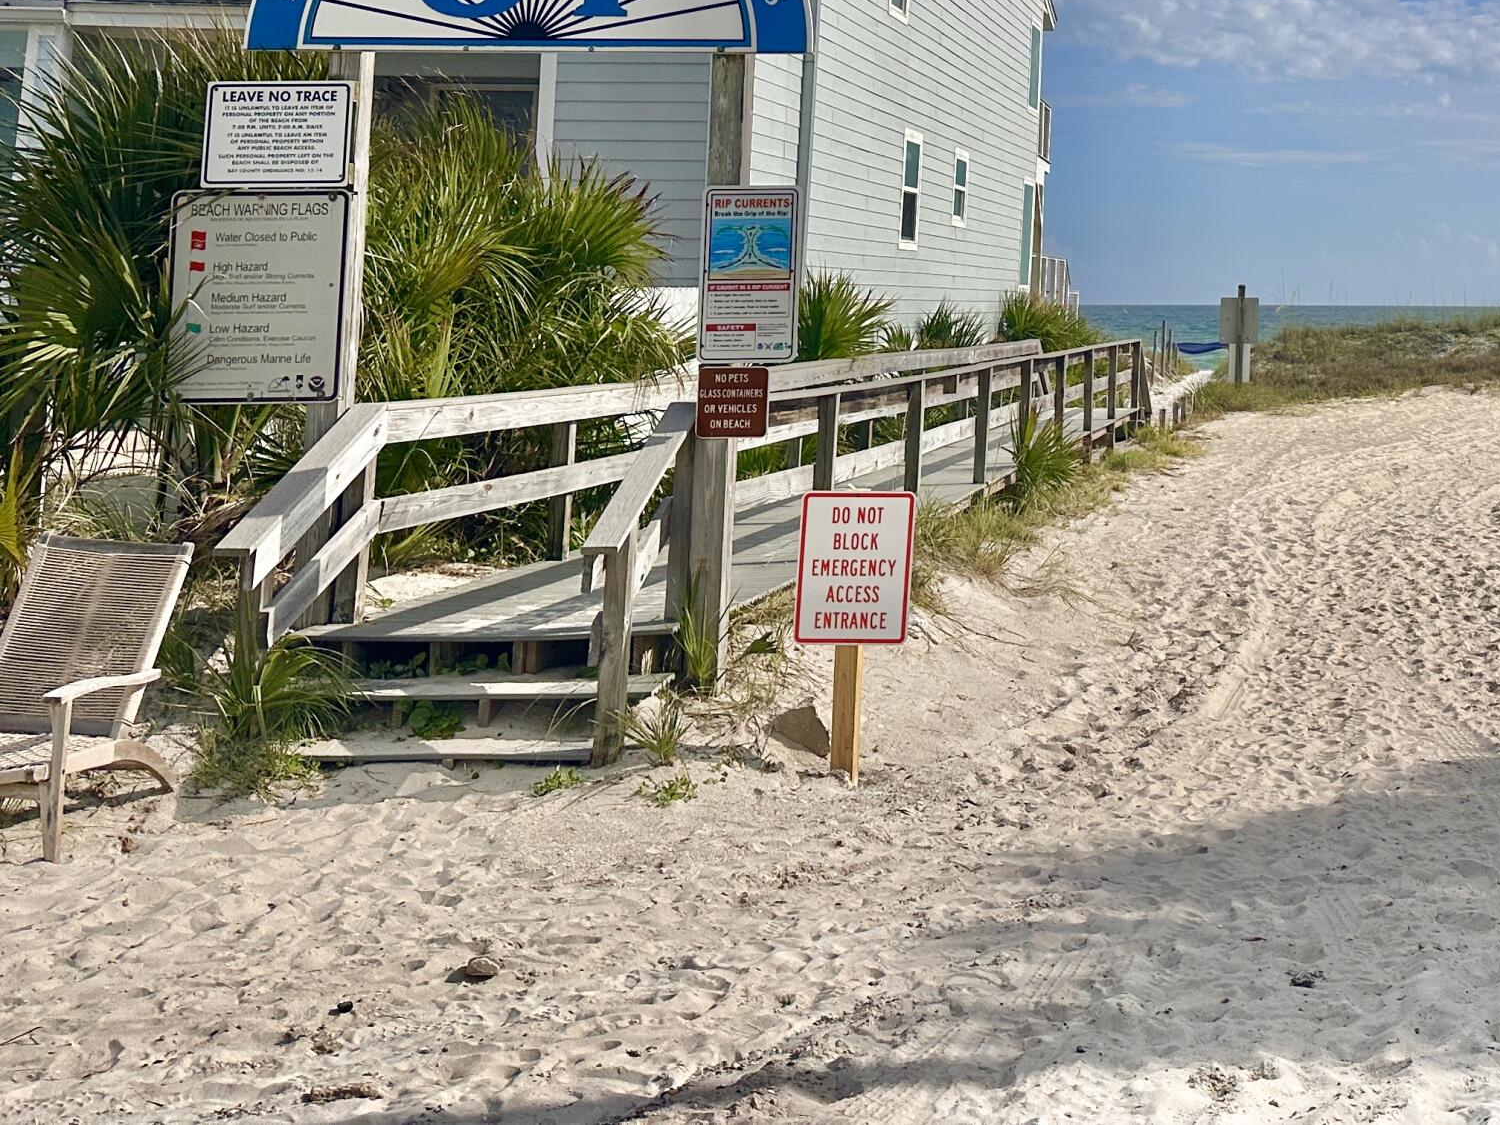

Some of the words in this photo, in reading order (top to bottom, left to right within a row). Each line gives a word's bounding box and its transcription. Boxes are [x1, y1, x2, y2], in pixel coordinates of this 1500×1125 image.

[222, 90, 264, 102] LEAVE
[268, 90, 291, 102] NO
[295, 90, 338, 102] TRACE
[191, 203, 231, 216] BEACH
[233, 203, 288, 216] WARNING
[291, 203, 329, 216] FLAGS
[714, 199, 732, 208] RIP
[734, 199, 790, 208] CURRENTS
[215, 232, 241, 242] Water
[244, 231, 277, 242] Closed
[279, 231, 288, 242] to
[290, 231, 318, 242] Public
[213, 262, 233, 274] High
[236, 261, 268, 271] Hazard
[211, 292, 249, 303] Medium
[252, 292, 287, 303] Hazard
[209, 324, 230, 333] Low
[233, 323, 270, 333] Hazard
[207, 354, 258, 367] Dangerous
[260, 354, 292, 364] Marine
[295, 353, 312, 363] Life
[715, 373, 727, 383] NO
[728, 373, 749, 383] PETS
[700, 389, 721, 398] GLASS
[722, 389, 763, 398] CONTAINERS
[704, 404, 716, 414] OR
[718, 404, 757, 414] VEHICLES
[710, 419, 721, 429] ON
[723, 419, 751, 429] BEACH
[832, 507, 851, 524] DO
[857, 507, 884, 524] NOT
[833, 533, 879, 550] BLOCK
[812, 559, 897, 577] EMERGENCY
[826, 585, 880, 603] ACCESS
[814, 612, 887, 629] ENTRANCE
